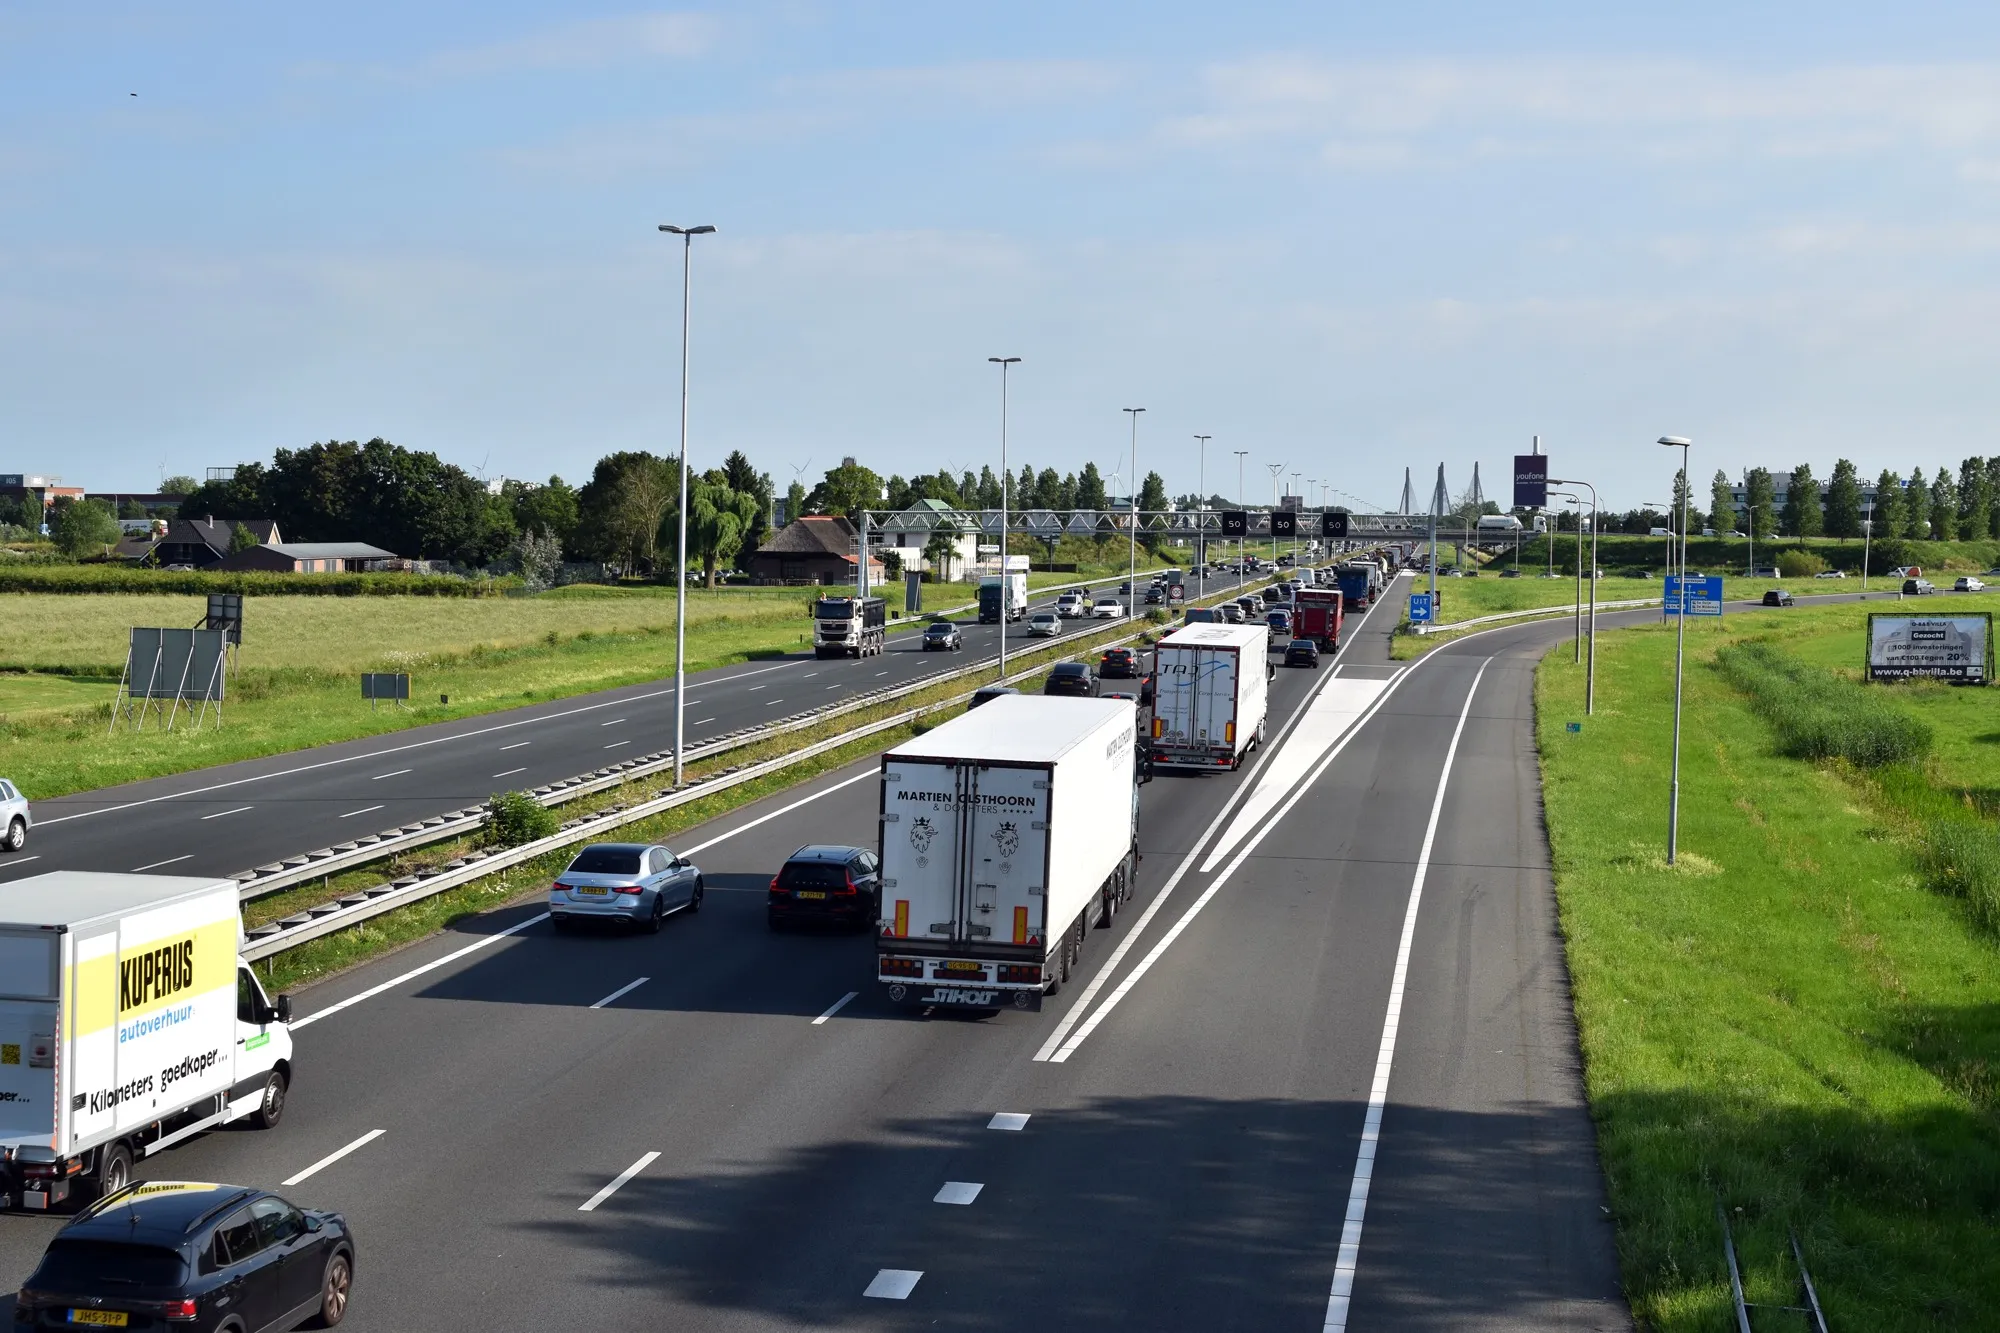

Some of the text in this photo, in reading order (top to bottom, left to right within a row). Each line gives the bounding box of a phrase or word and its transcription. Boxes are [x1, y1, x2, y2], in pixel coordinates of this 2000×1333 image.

[1516, 472, 1545, 481] youfone
[1228, 520, 1241, 528] 50
[1277, 521, 1290, 529] 50
[1328, 521, 1341, 529] 50
[1912, 644, 1964, 652] investeringen
[1920, 654, 1945, 662] tegen
[1946, 652, 1970, 661] 20%
[1874, 667, 1963, 676] www.q-bbvilla.be
[897, 790, 1037, 807] MARTIEN OLSTHOORN
[932, 803, 941, 812] &
[120, 939, 193, 1013] KUPERUS
[120, 1005, 193, 1044] autoverhuur
[90, 1074, 154, 1116] Kilometers
[78, 1311, 123, 1324] JHS-31-P
